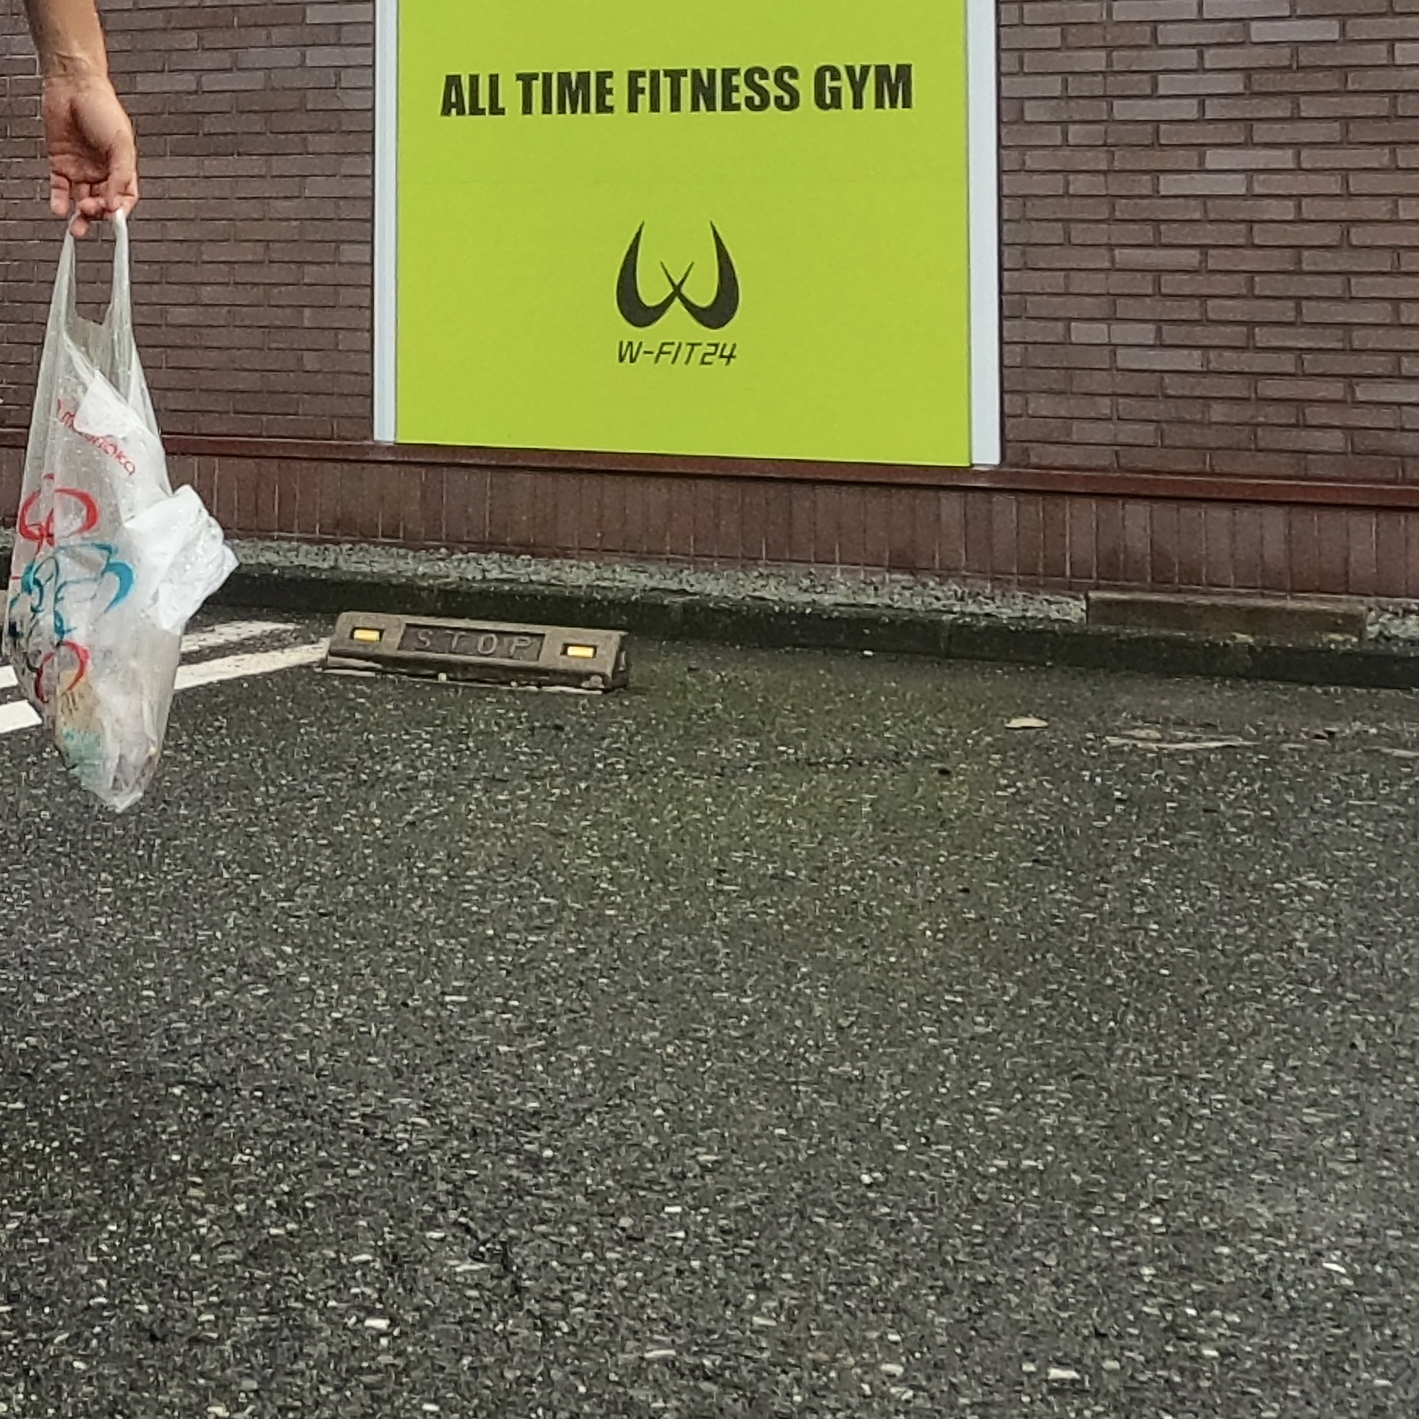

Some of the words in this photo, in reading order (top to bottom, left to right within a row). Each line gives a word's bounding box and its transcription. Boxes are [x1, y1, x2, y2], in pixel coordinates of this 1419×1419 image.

[440, 73, 506, 117] ALL
[515, 70, 615, 116] TIME
[627, 65, 800, 114] FITNESS
[813, 63, 913, 111] GYM
[618, 340, 737, 366] W-FIT24
[414, 630, 532, 659] STOP
